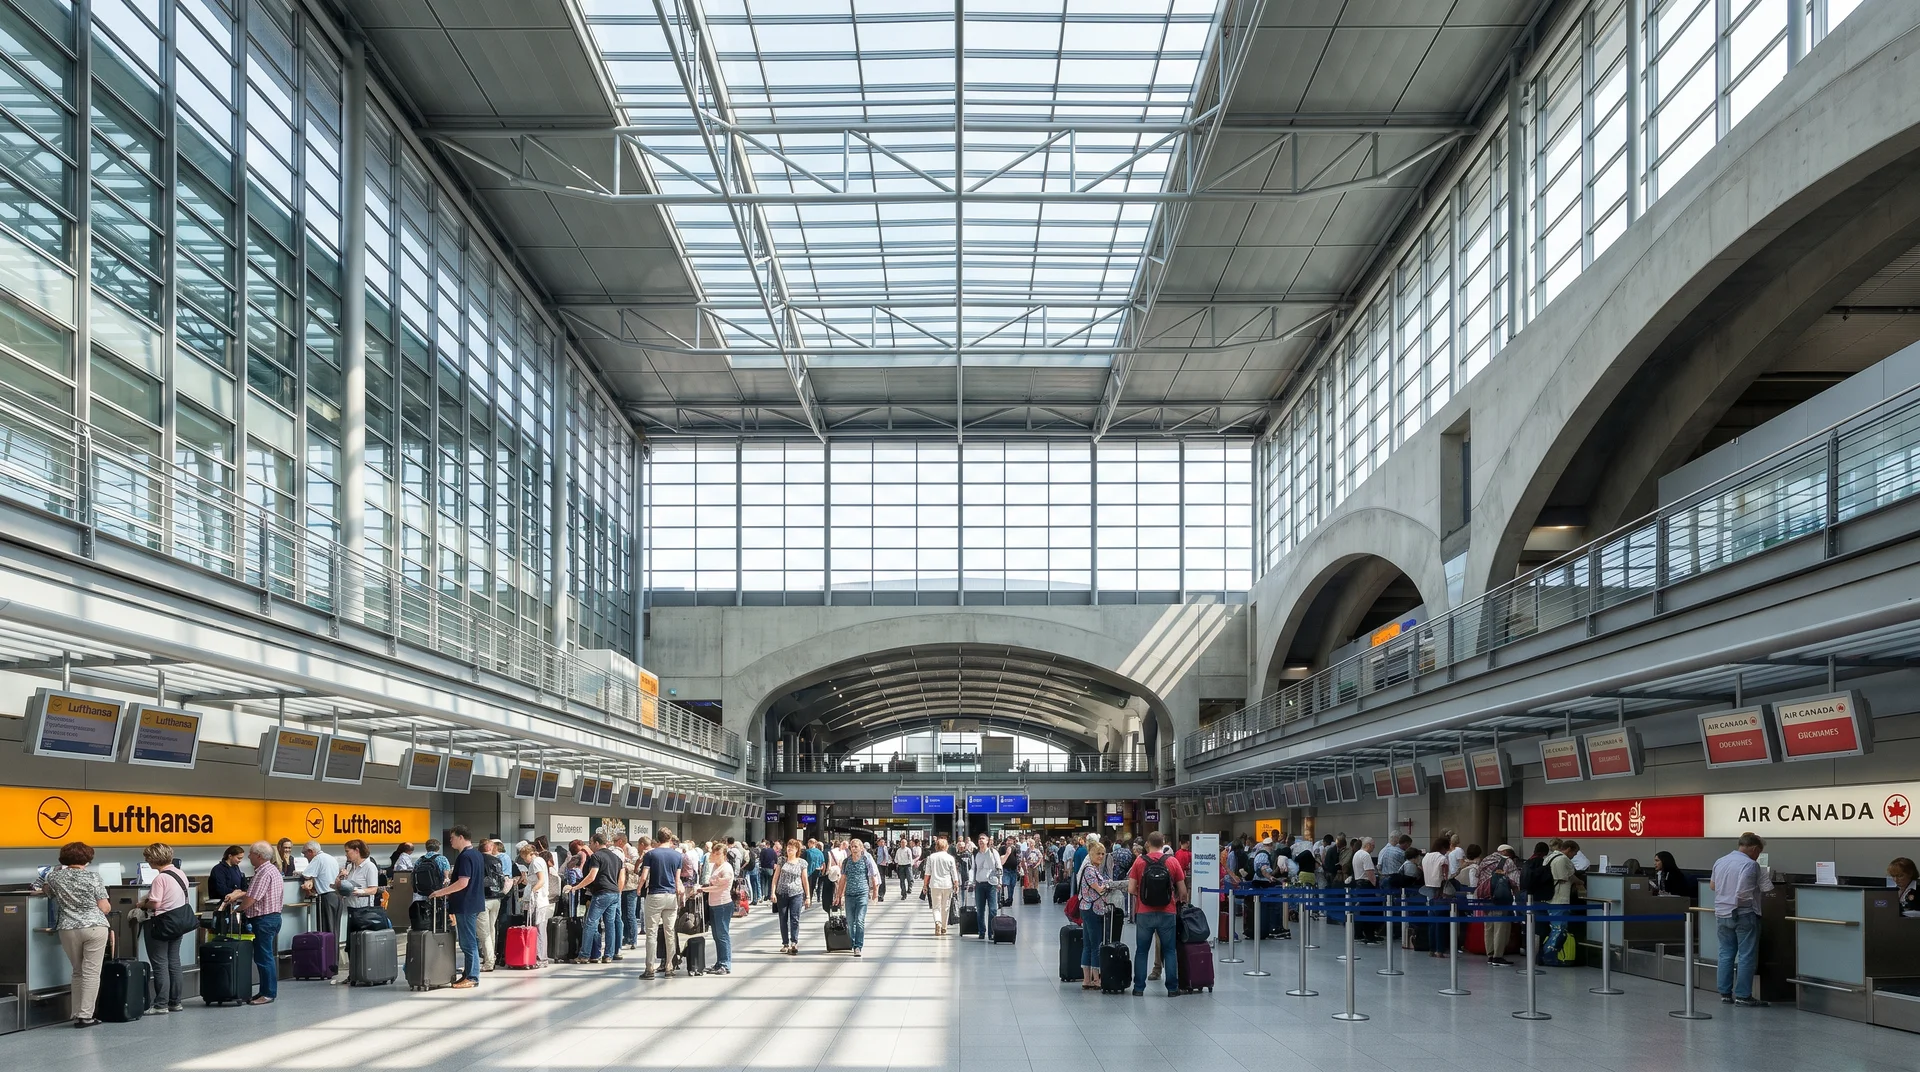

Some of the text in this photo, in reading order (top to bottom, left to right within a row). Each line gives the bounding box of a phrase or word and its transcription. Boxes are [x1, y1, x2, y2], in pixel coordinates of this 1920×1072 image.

[68, 702, 112, 717] Lufthansa
[1784, 706, 1835, 719] AIR CANADA
[94, 804, 214, 833] Lufthansa
[1558, 807, 1623, 832] Emirates
[1738, 802, 1874, 823] AIR CANADA
[334, 813, 402, 834] Lufthansa
